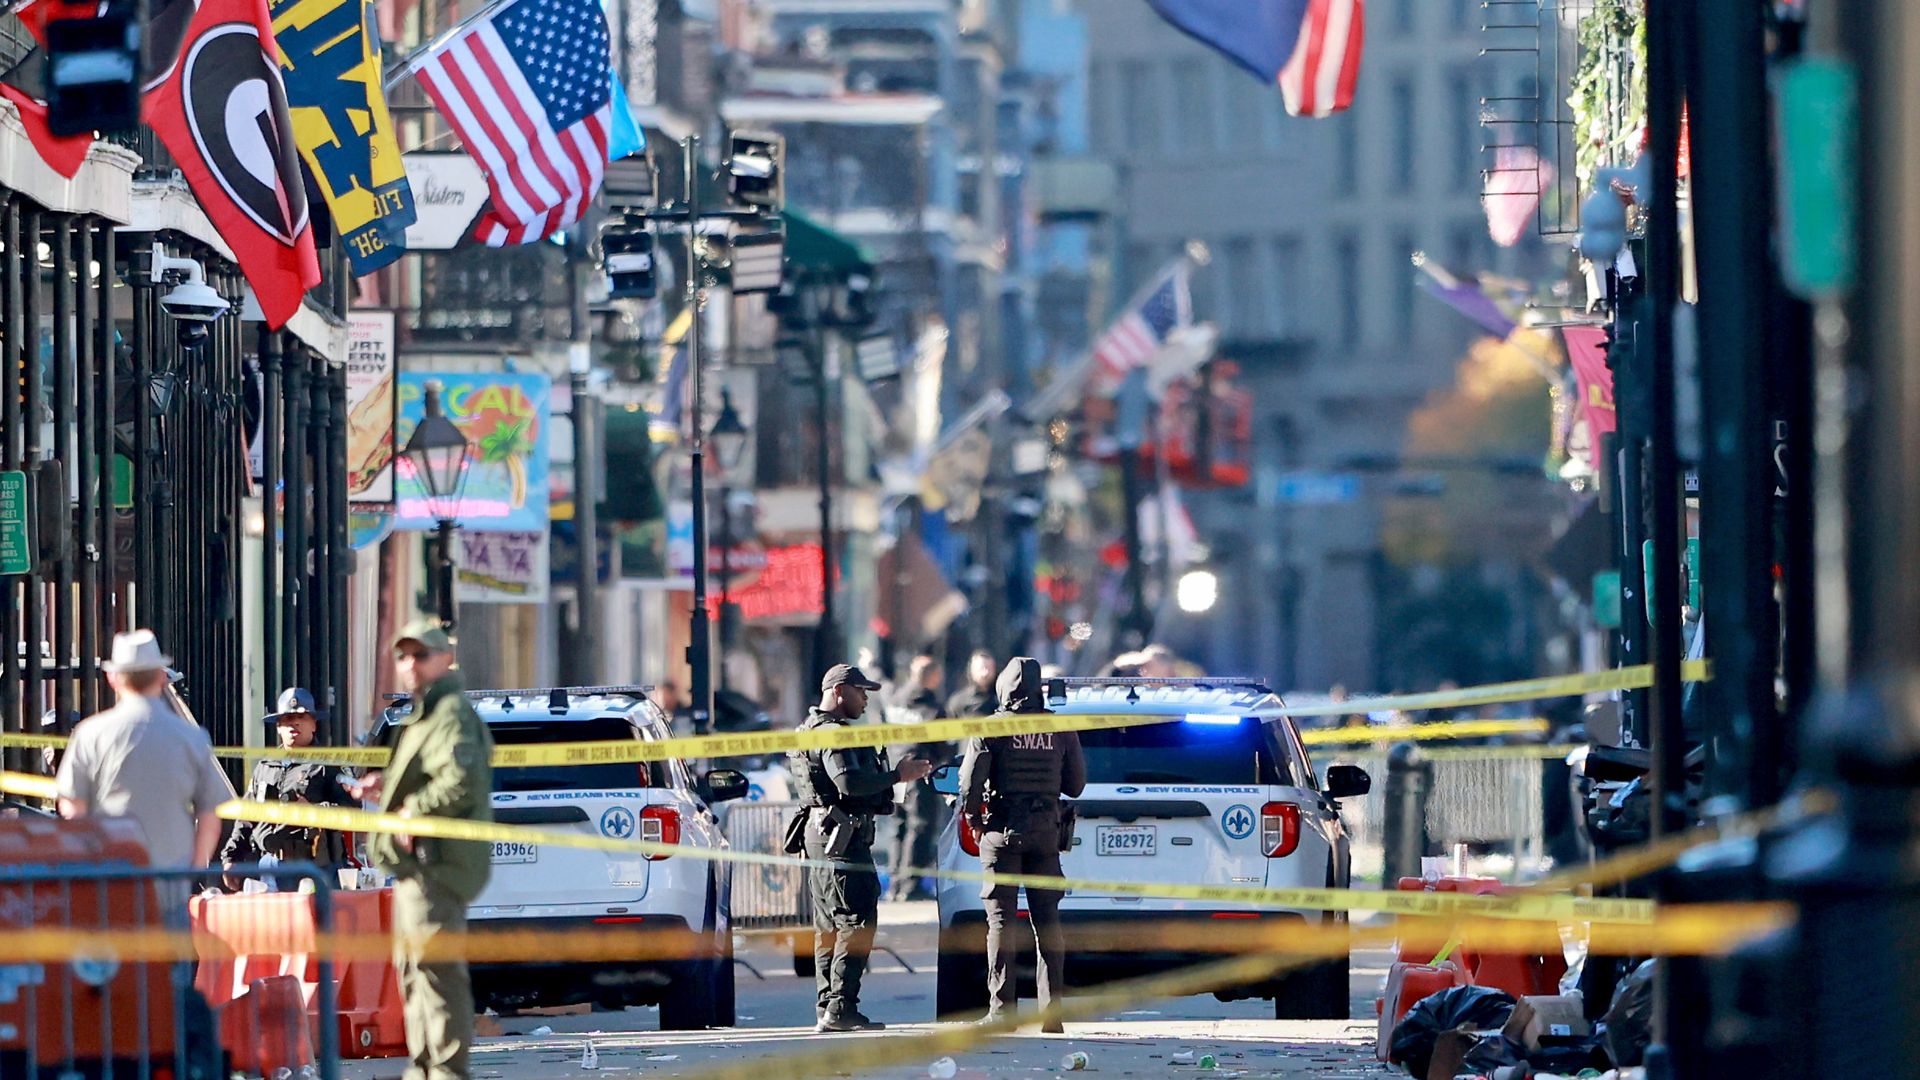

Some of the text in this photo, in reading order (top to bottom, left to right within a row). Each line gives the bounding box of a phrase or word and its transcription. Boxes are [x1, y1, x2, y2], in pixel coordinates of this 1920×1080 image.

[416, 175, 466, 208] Sisters
[349, 364, 387, 374] BOY
[398, 383, 537, 417] PCAL
[462, 540, 532, 576] YA YA
[1013, 733, 1053, 750] S.W.A.T.
[566, 748, 588, 761] CRIME
[591, 746, 614, 760] SCENE
[527, 791, 641, 801] NEW ORLEANS POLICE
[1224, 786, 1260, 794] POLICE
[1108, 834, 1154, 848] 282972
